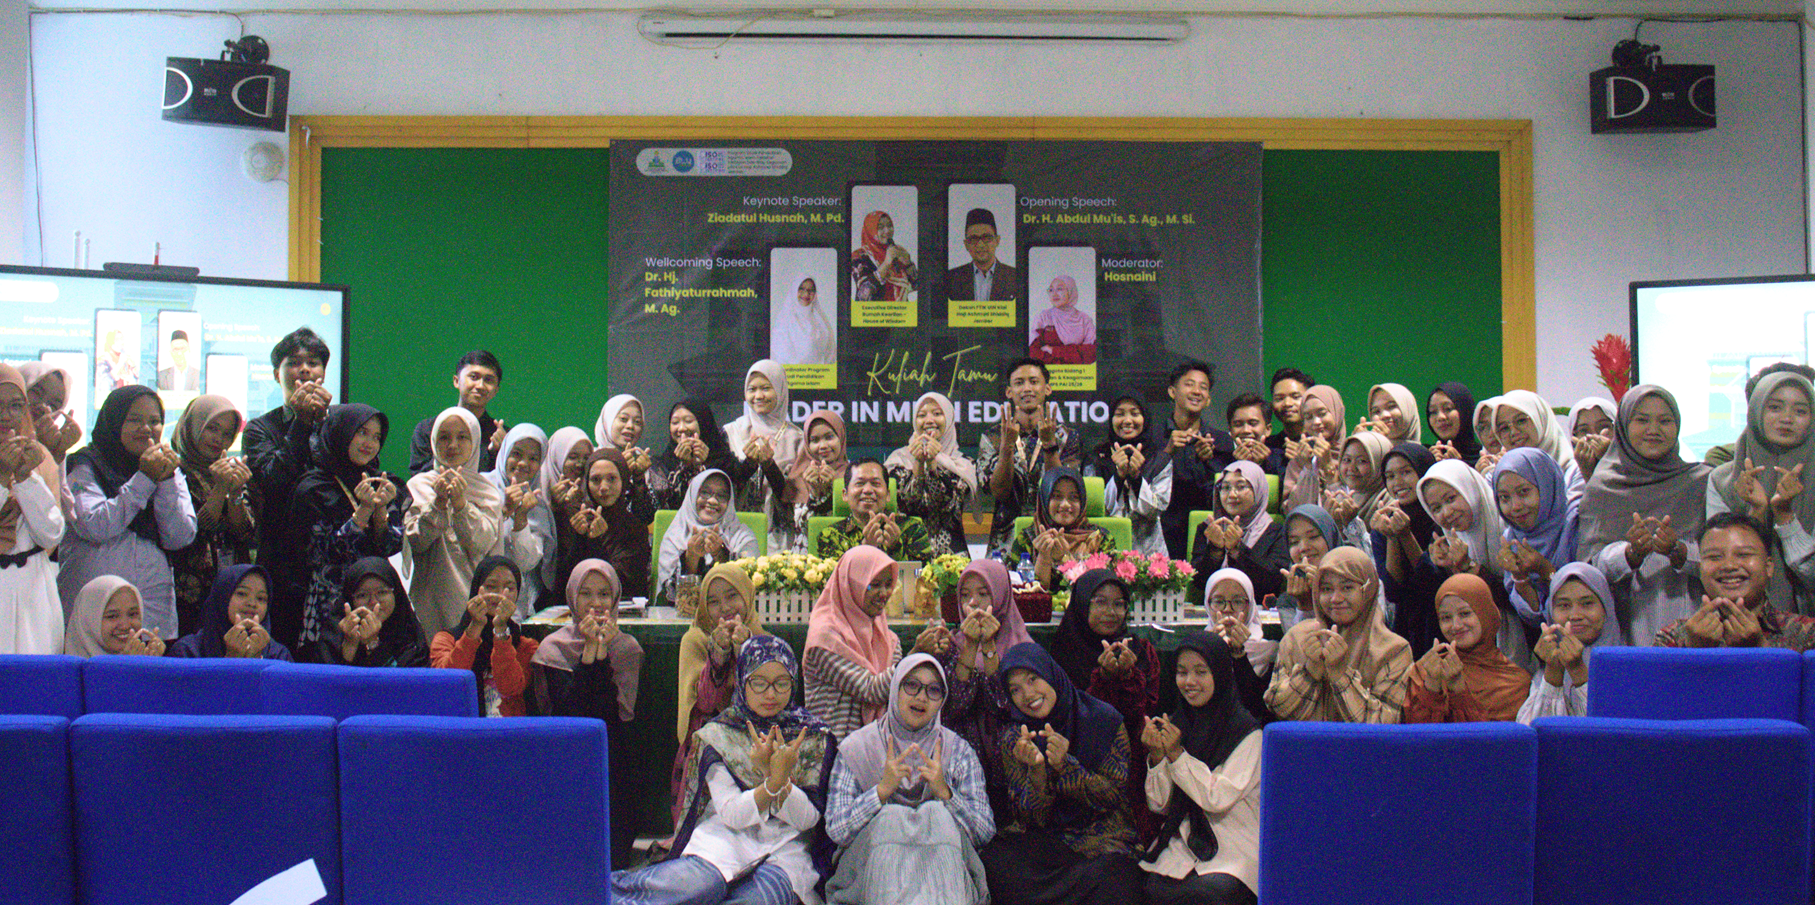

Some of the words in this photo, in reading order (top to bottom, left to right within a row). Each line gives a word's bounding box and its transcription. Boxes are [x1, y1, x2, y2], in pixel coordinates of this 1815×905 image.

[743, 195, 789, 208] Keynote
[792, 195, 842, 208] Speaker:
[1020, 196, 1069, 209] Opening
[1072, 196, 1118, 209] Speech:
[707, 212, 757, 223] Ziadatul
[759, 212, 808, 224] Husnah,
[810, 213, 824, 223] M.
[826, 213, 845, 223] Pd.
[1022, 213, 1040, 224] Dr.
[1041, 213, 1053, 223] H.
[1056, 213, 1091, 223] Abdul
[1093, 212, 1127, 224] Mu'is,
[1128, 213, 1139, 223] S.
[1141, 213, 1164, 227] Ag.,
[1166, 213, 1180, 224] M.
[1182, 212, 1196, 224] Si.
[645, 257, 713, 270] Wellcoming
[716, 257, 762, 269] Speech:
[1101, 257, 1164, 268] Moderator:
[645, 271, 661, 281] Dr.
[663, 271, 679, 284] Hj.
[1104, 270, 1157, 281] Hosnaini
[645, 286, 758, 300] Fathiyaturrahmah,
[645, 303, 659, 313] M.
[660, 303, 680, 317] Ag.
[867, 348, 937, 396] Kuliah
[942, 344, 998, 398] Tamu
[851, 400, 879, 423] IN
